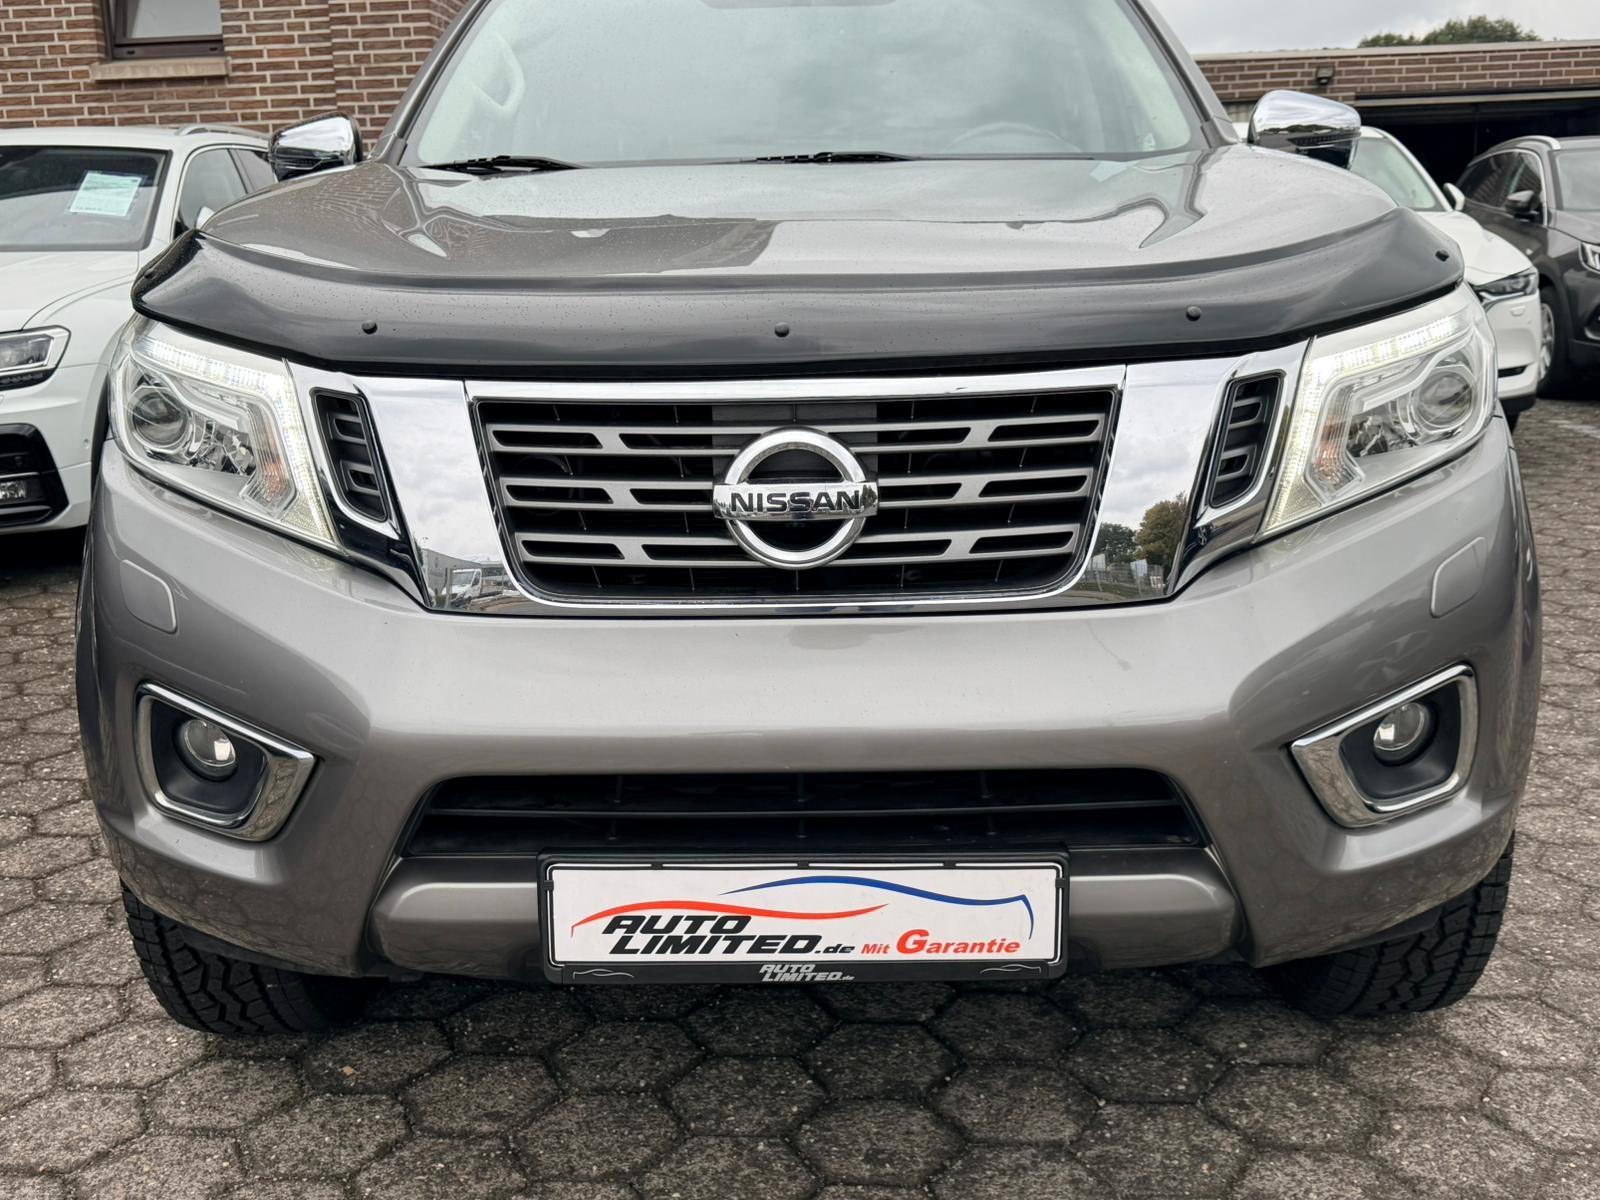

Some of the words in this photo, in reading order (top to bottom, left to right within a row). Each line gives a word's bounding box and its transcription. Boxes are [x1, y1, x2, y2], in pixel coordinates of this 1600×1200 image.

[730, 490, 860, 513] NISSAN
[602, 915, 752, 935] AUTO
[608, 935, 855, 955] LIMITED.de
[860, 942, 890, 955] Mit
[896, 928, 1021, 955] Garantie
[759, 963, 816, 973] AUTO
